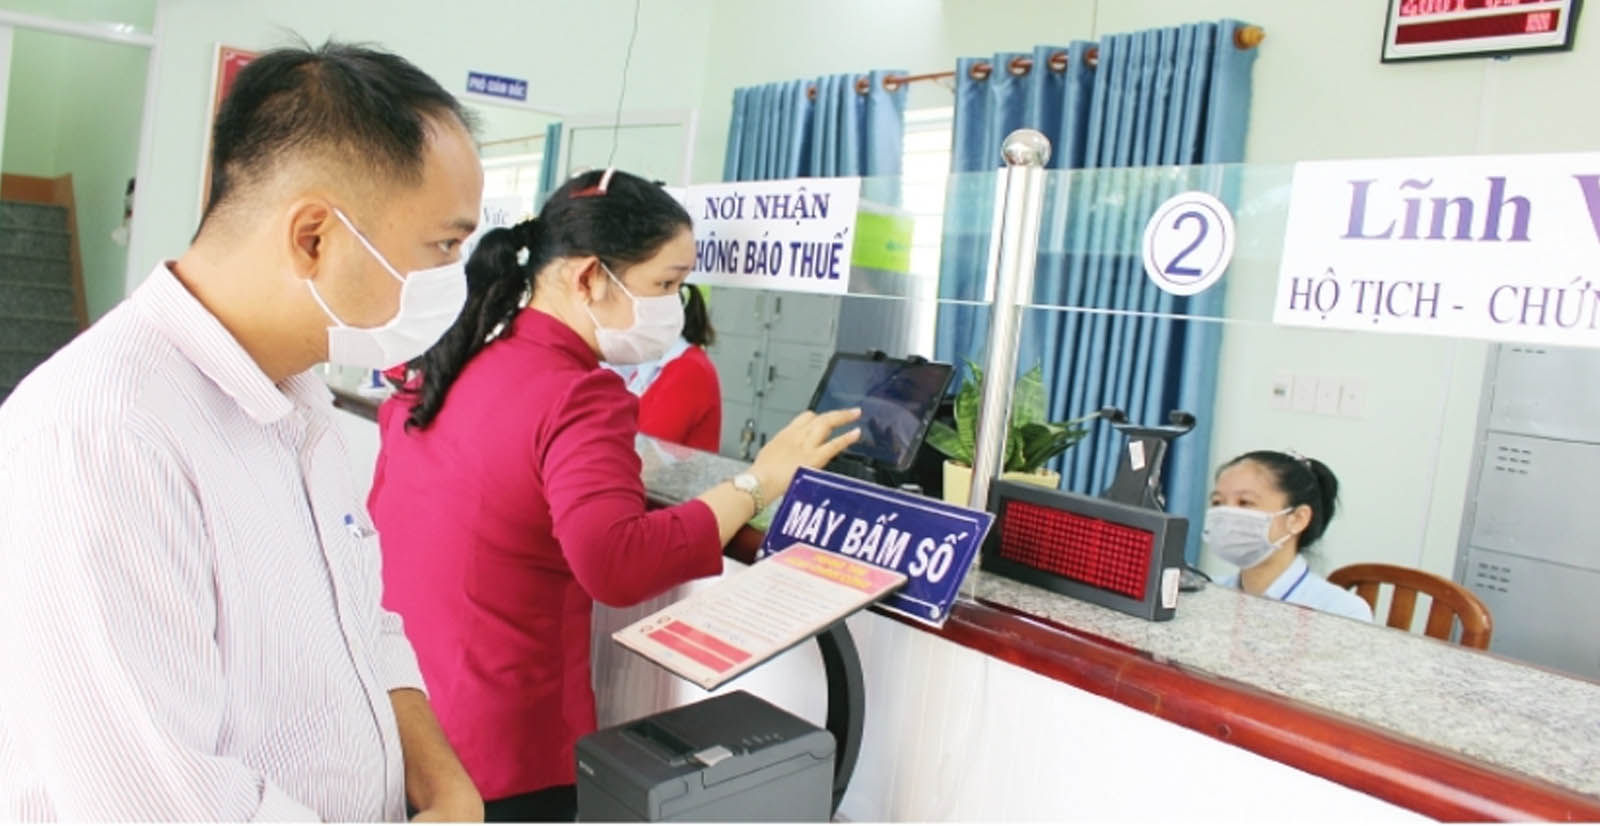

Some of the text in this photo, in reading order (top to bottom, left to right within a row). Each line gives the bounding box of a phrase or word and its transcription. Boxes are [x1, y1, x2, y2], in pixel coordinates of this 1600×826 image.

[704, 187, 831, 226] NƠI NHẬN
[1340, 177, 1532, 242] Lĩnh
[693, 227, 848, 280] HÔNG BÁO THUẾ
[1164, 211, 1209, 276] 2
[1289, 266, 1340, 320] HỘ
[1351, 279, 1441, 324] TỊCH
[782, 499, 846, 547] MÁY
[840, 512, 912, 569] BẤM
[908, 531, 969, 584] SỐ
